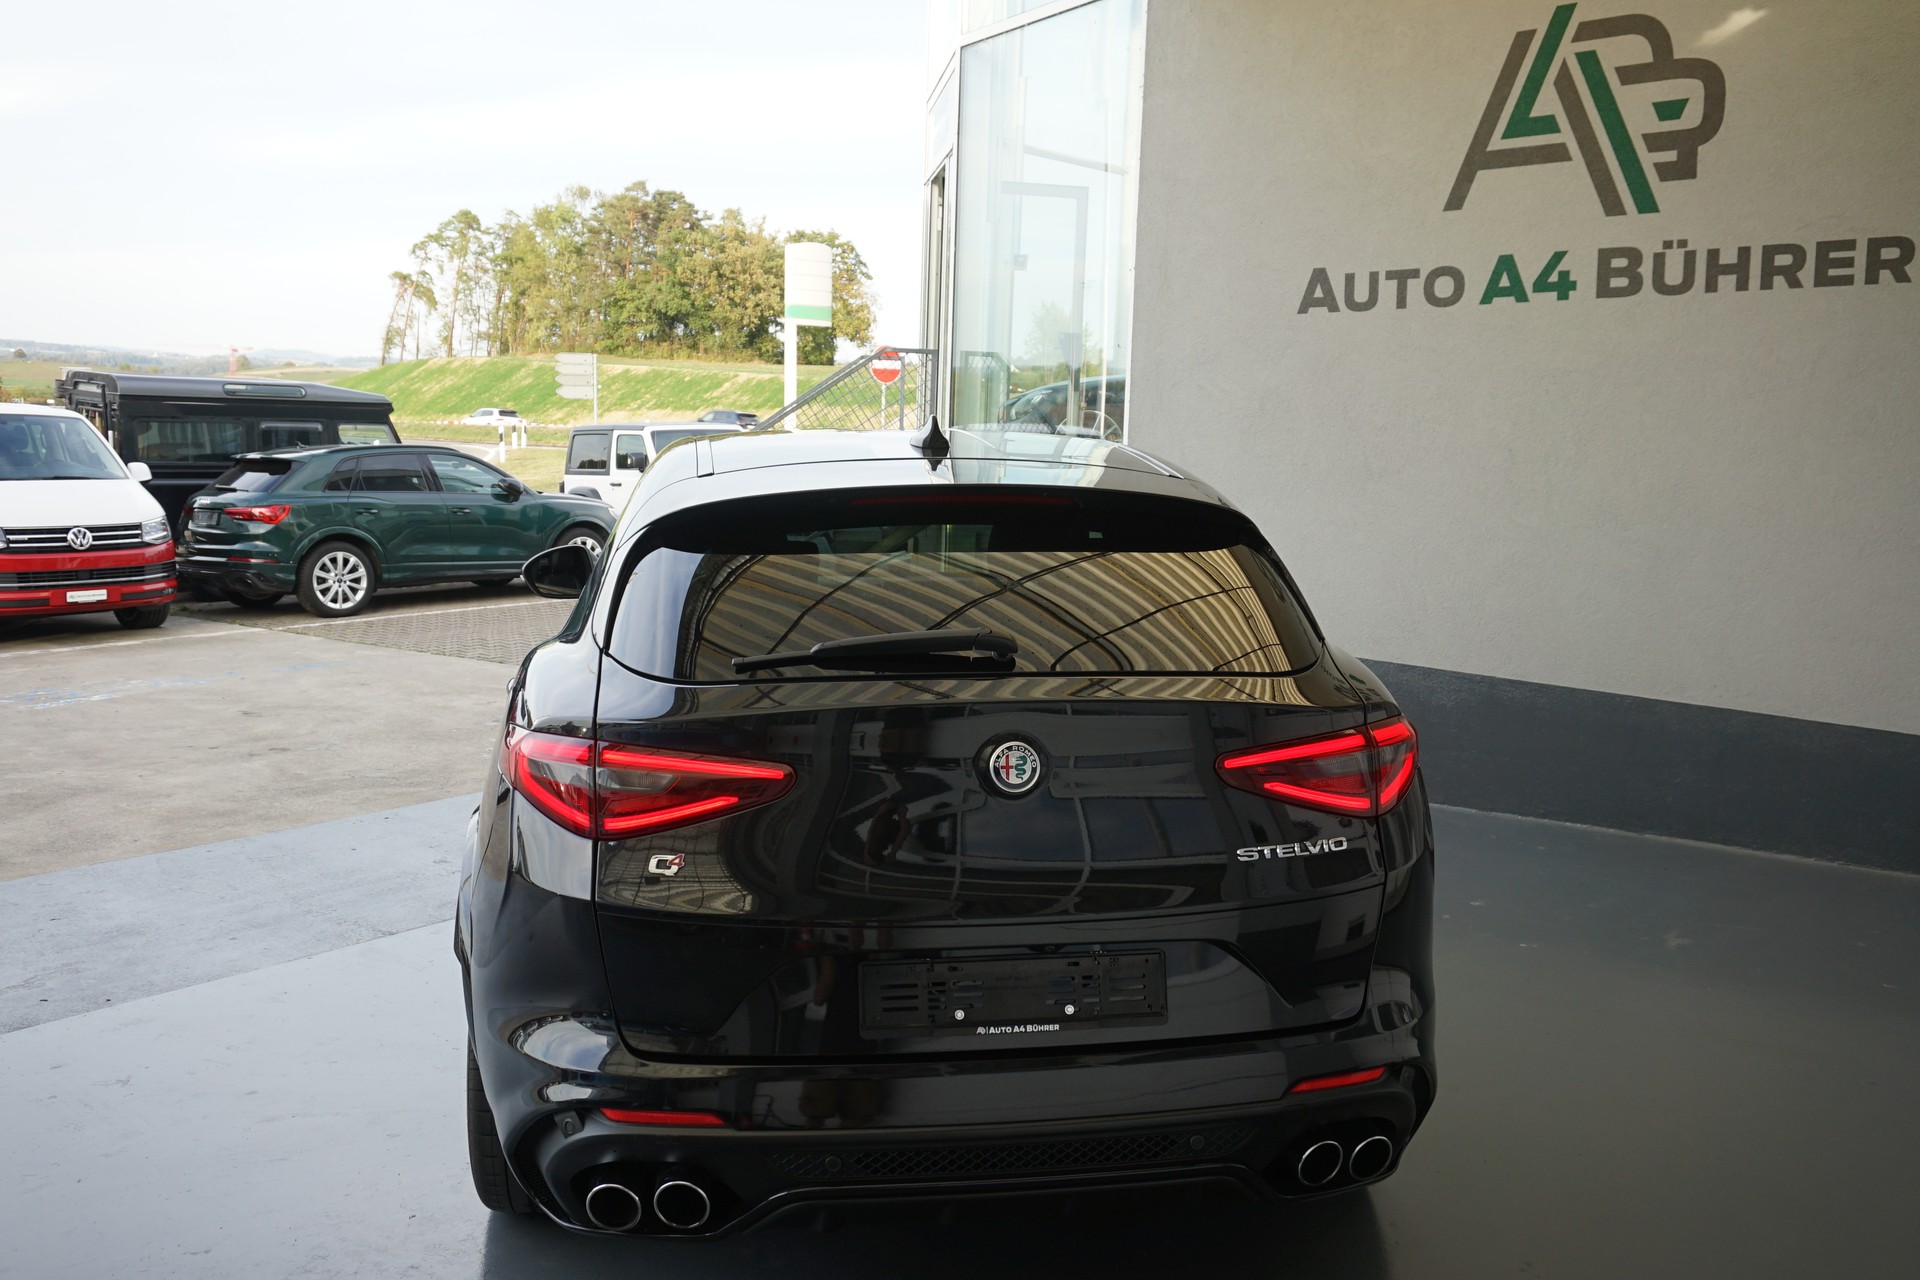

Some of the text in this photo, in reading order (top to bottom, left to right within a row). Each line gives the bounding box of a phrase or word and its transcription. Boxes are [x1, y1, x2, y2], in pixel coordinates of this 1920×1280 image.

[1297, 236, 1917, 315] AUTO A4 BÜHRER
[994, 745, 1037, 768] ALFA ROMEO
[1237, 836, 1348, 862] STELVIO
[989, 1026, 1012, 1034] AUTO
[1013, 1025, 1025, 1033] A4
